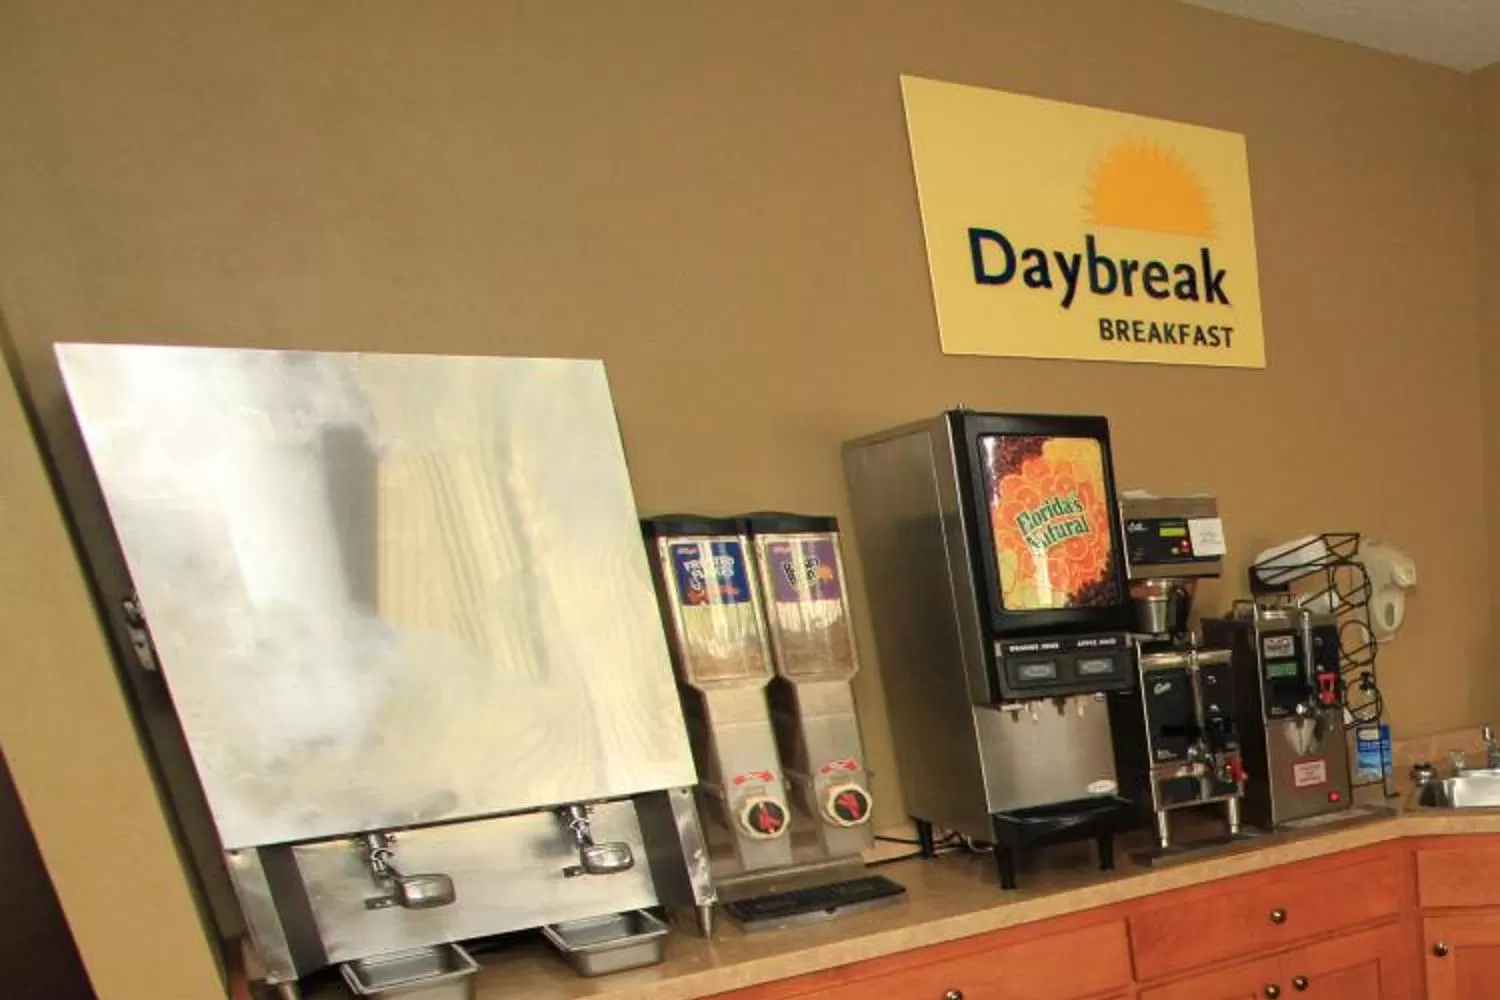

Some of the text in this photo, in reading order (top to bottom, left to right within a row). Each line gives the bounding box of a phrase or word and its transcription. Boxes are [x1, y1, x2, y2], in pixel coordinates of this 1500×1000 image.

[967, 226, 1230, 310] Daybreak
[1098, 317, 1234, 349] BREAKFAST
[1016, 497, 1083, 536] Florida's
[1026, 515, 1090, 549] Natural
